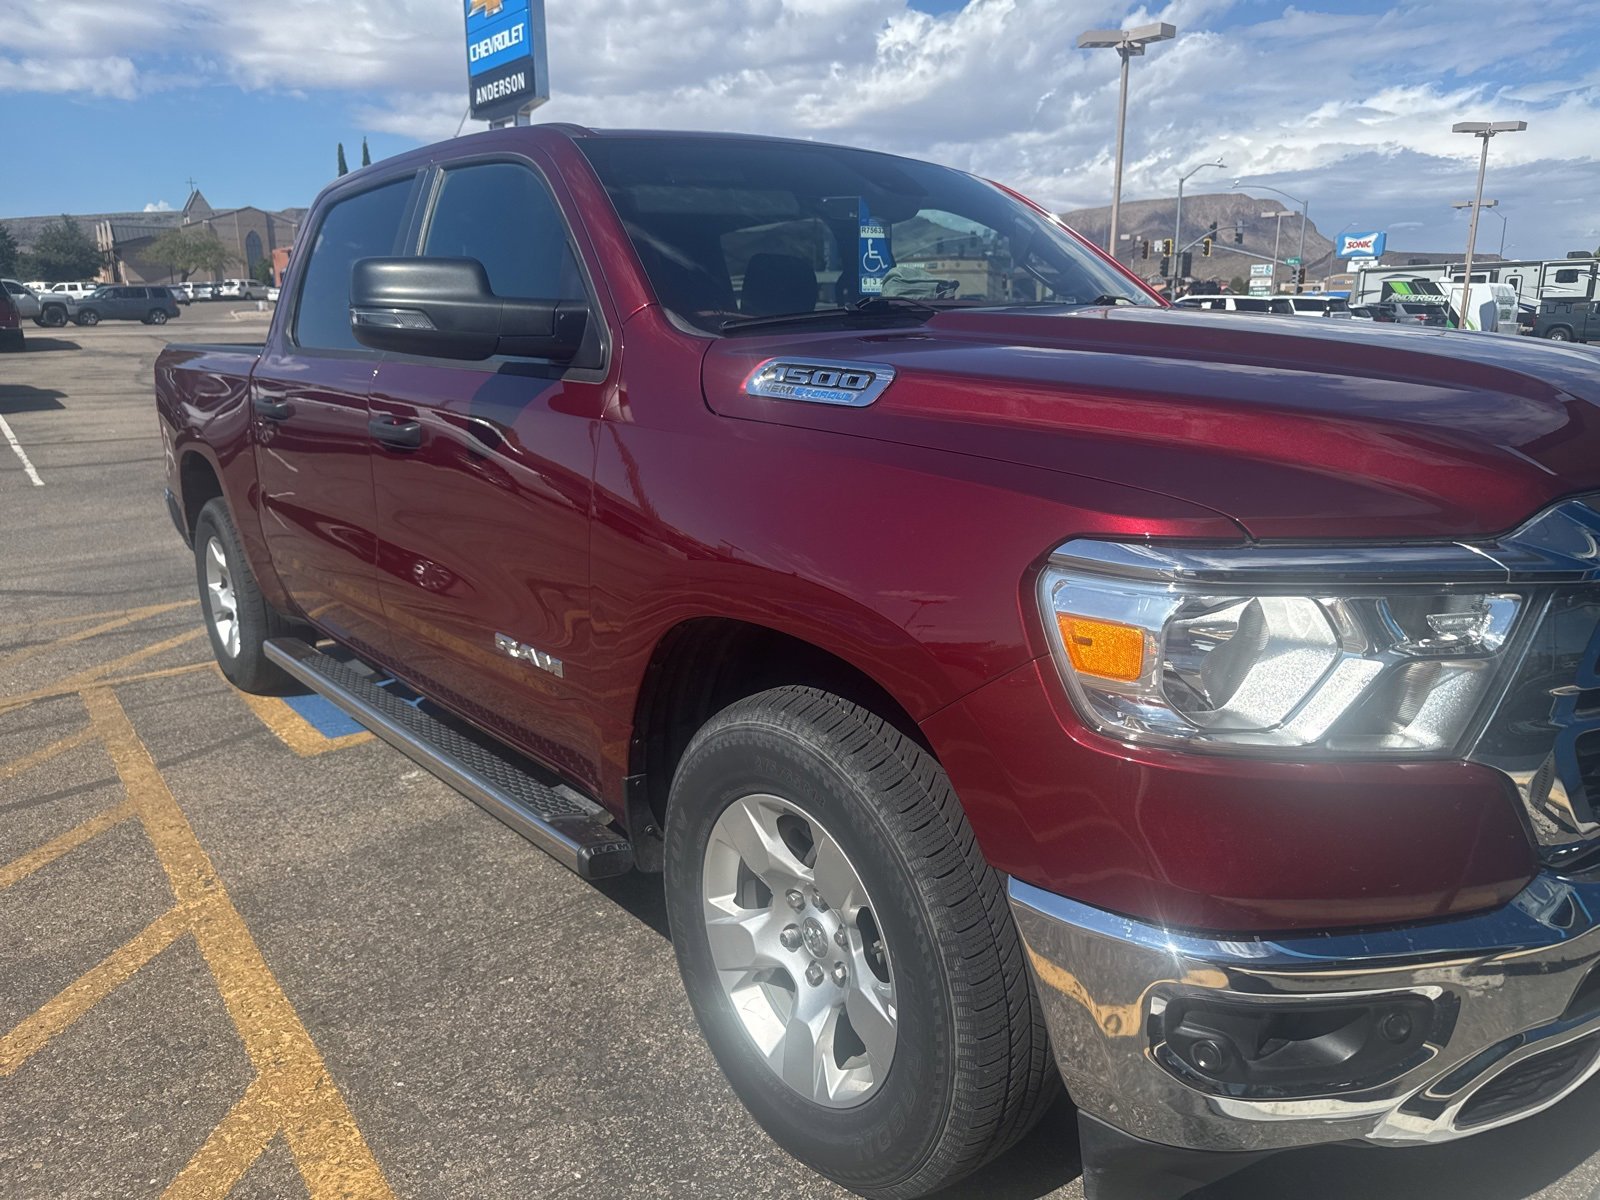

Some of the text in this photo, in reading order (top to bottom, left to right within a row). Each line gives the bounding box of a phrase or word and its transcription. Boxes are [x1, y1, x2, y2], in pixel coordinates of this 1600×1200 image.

[469, 23, 525, 62] CHEVROLET
[475, 72, 526, 105] ANDERSON
[1346, 240, 1372, 249] SONIC
[1384, 292, 1450, 303] ANDERSON
[762, 363, 873, 390] 1500
[759, 383, 794, 395] HEMI
